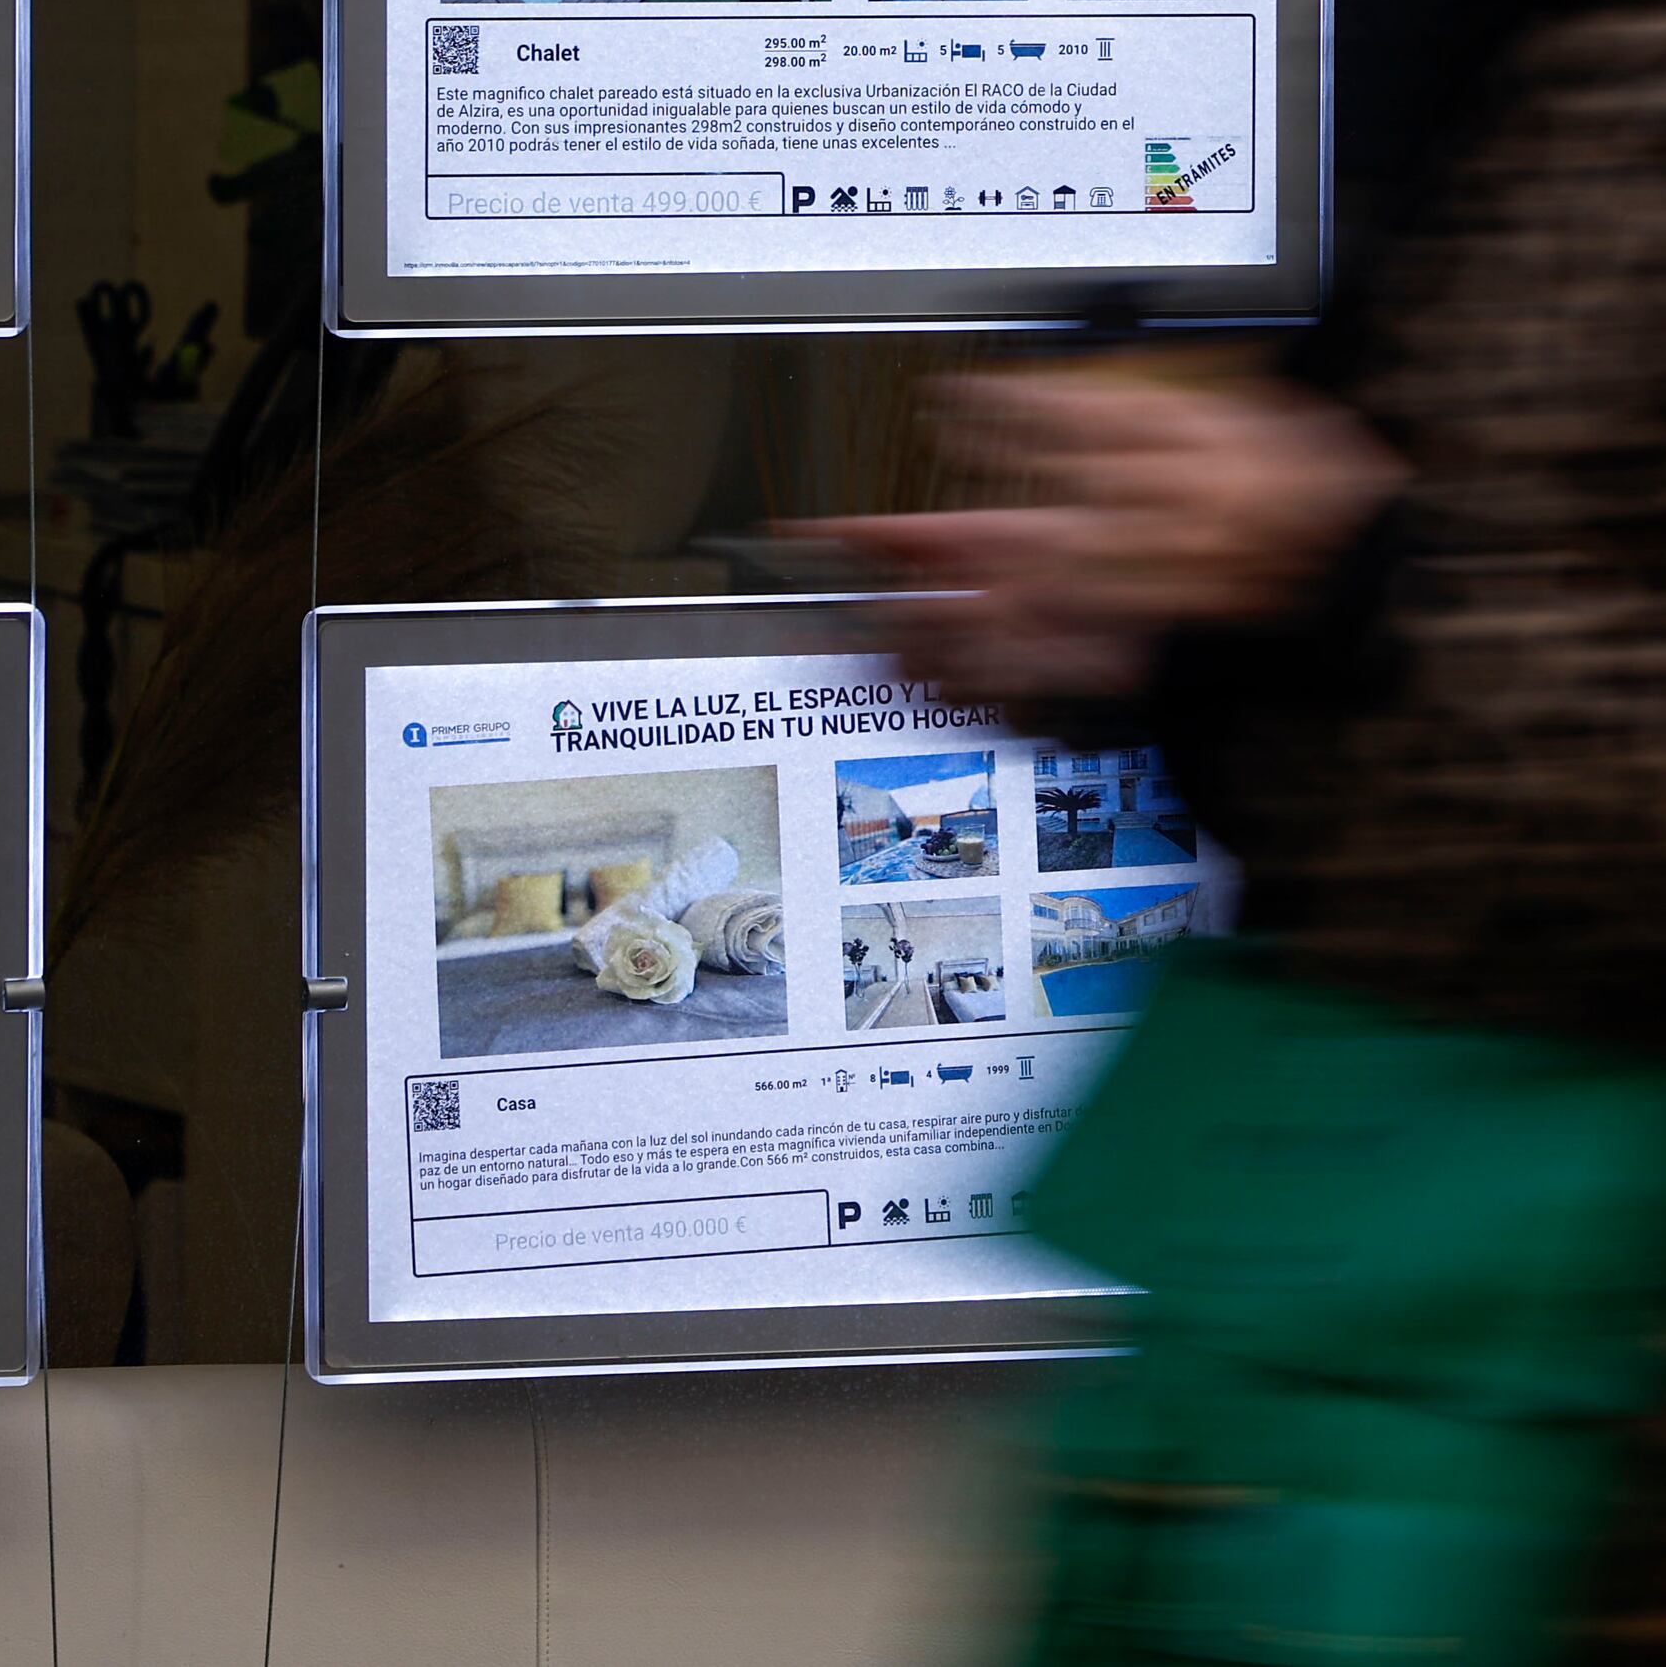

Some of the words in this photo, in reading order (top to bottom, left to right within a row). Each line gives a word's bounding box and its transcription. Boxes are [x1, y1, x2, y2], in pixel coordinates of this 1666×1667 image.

[516, 43, 580, 62] Chalet
[1058, 44, 1089, 55] 2010
[437, 86, 469, 101] Este
[549, 85, 594, 100] chalet
[598, 85, 658, 103] pareado
[661, 86, 693, 100] está
[698, 84, 752, 99] situado
[755, 87, 773, 99] en
[777, 84, 790, 99] la
[794, 84, 862, 99] exclusiva
[866, 83, 960, 98] Urbanización
[965, 83, 978, 97] El
[982, 83, 1024, 97] RACO
[1028, 83, 1046, 97] de
[1050, 82, 1063, 97] la
[1066, 82, 1117, 97] Ciudad
[1156, 185, 1176, 205] EN
[1174, 143, 1236, 191] TRÁMITES
[448, 192, 524, 214] Precio
[532, 191, 561, 214] de
[570, 194, 633, 214] venta
[642, 190, 743, 213] 499.000
[748, 191, 762, 212] €
[592, 700, 647, 723] VIVE
[655, 698, 684, 719] LA
[694, 694, 746, 717] LUZ,
[754, 692, 782, 713] EL
[790, 684, 892, 710] ESPACIO
[899, 682, 916, 702] Y
[431, 724, 470, 735] PRIMER
[473, 721, 511, 733] GRUPO
[551, 722, 734, 753] TRANQUILIDAD
[744, 720, 774, 741] EN
[782, 717, 813, 738] TU
[822, 711, 905, 736] NUEVO
[913, 705, 1000, 731] HOGAR
[496, 1097, 536, 1112] Casa
